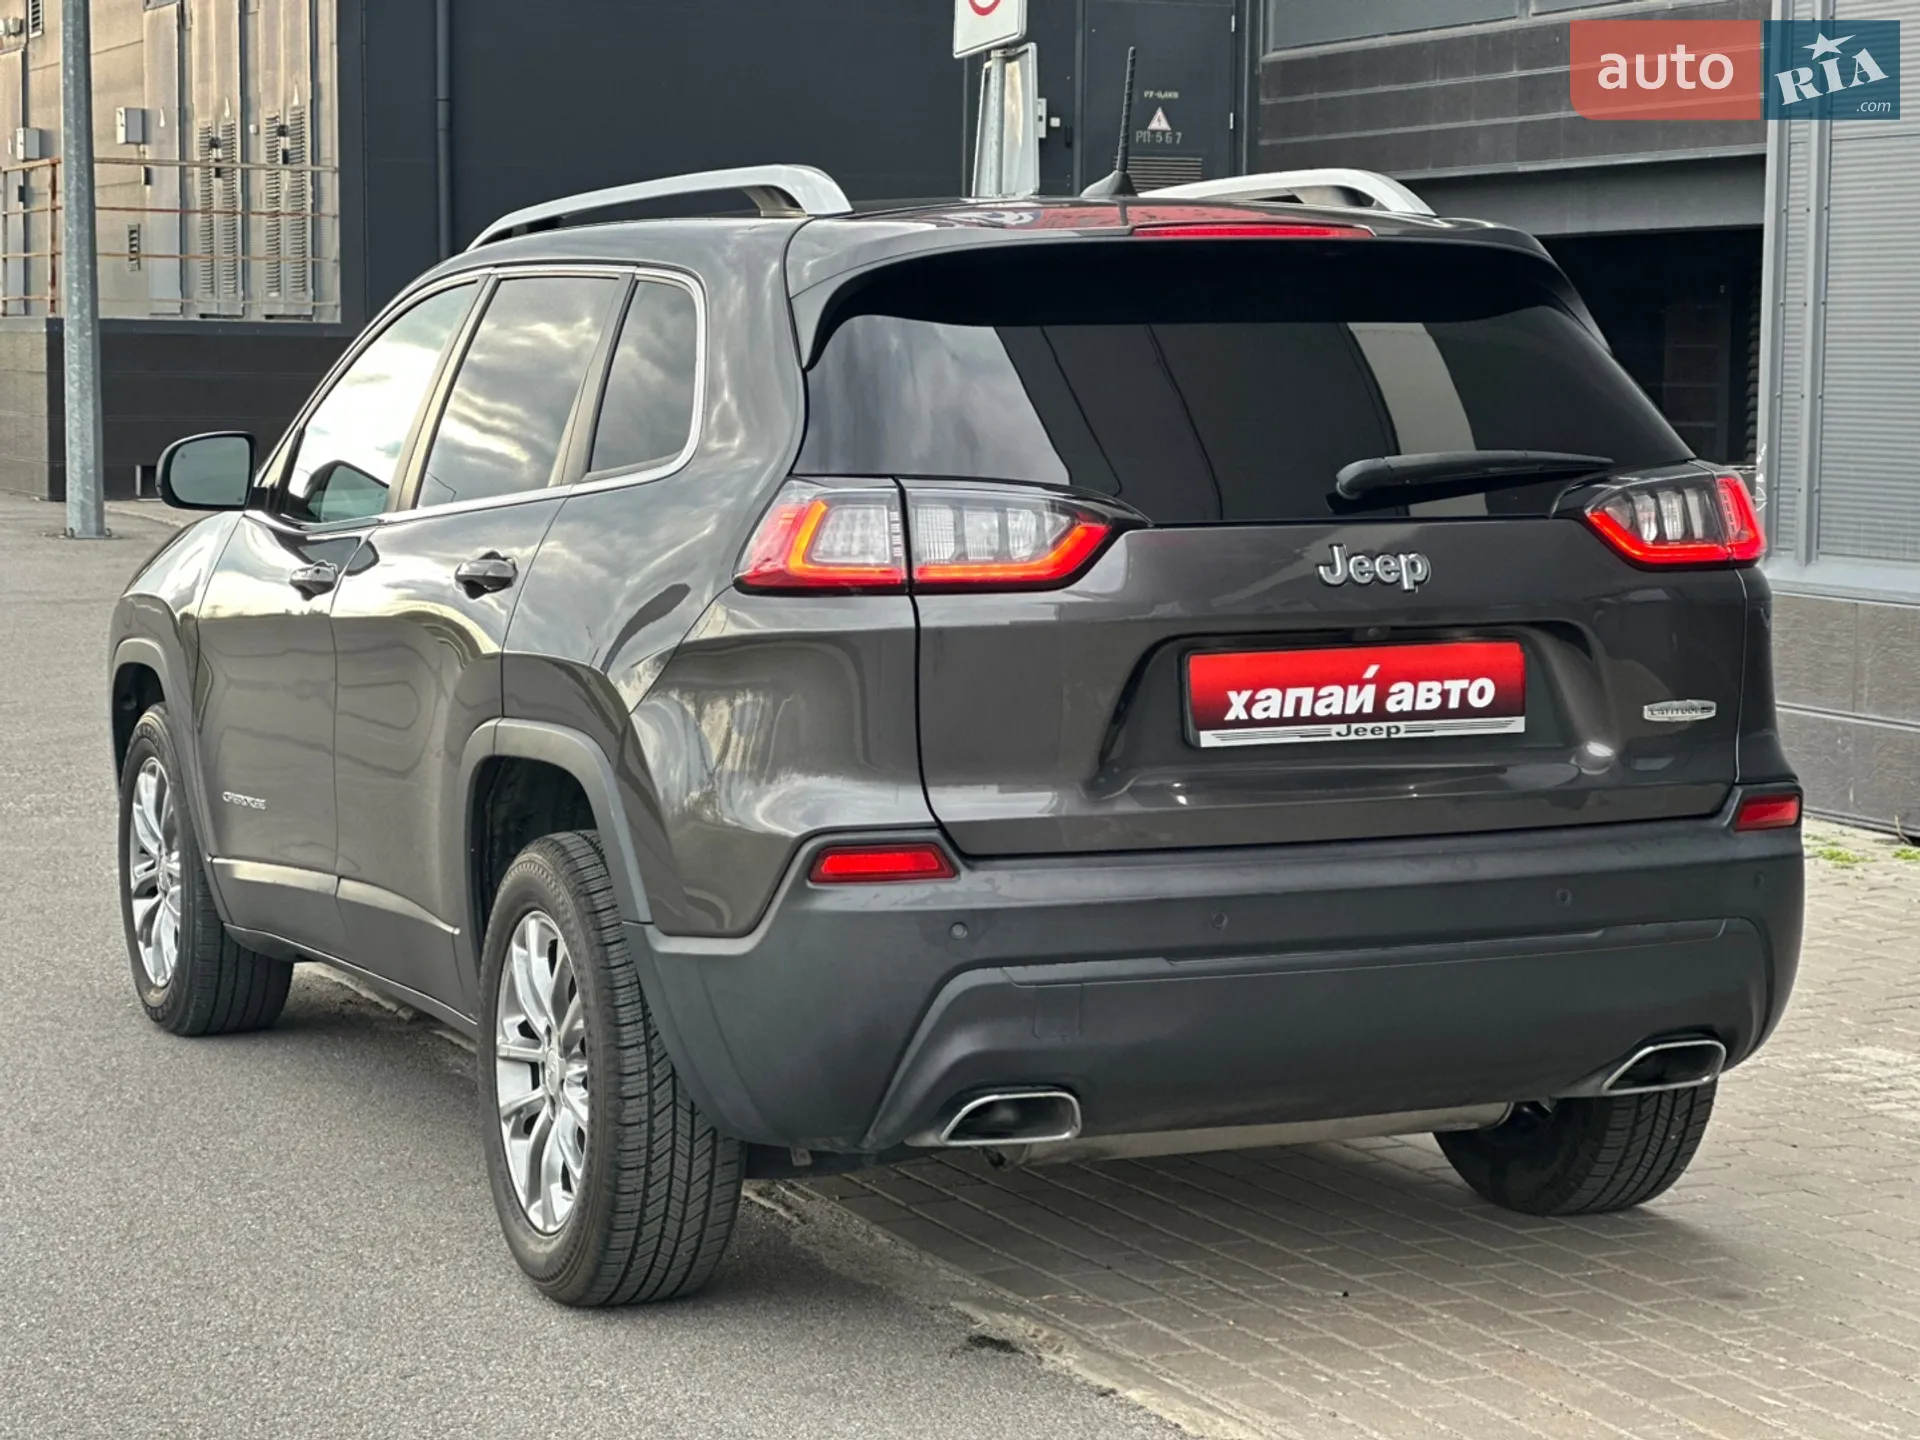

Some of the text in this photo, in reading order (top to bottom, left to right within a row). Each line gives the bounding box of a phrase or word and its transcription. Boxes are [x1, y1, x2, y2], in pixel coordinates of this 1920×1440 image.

[1316, 543, 1431, 593] Jeep
[1385, 677, 1496, 712] авто
[1335, 723, 1401, 739] Jeep
